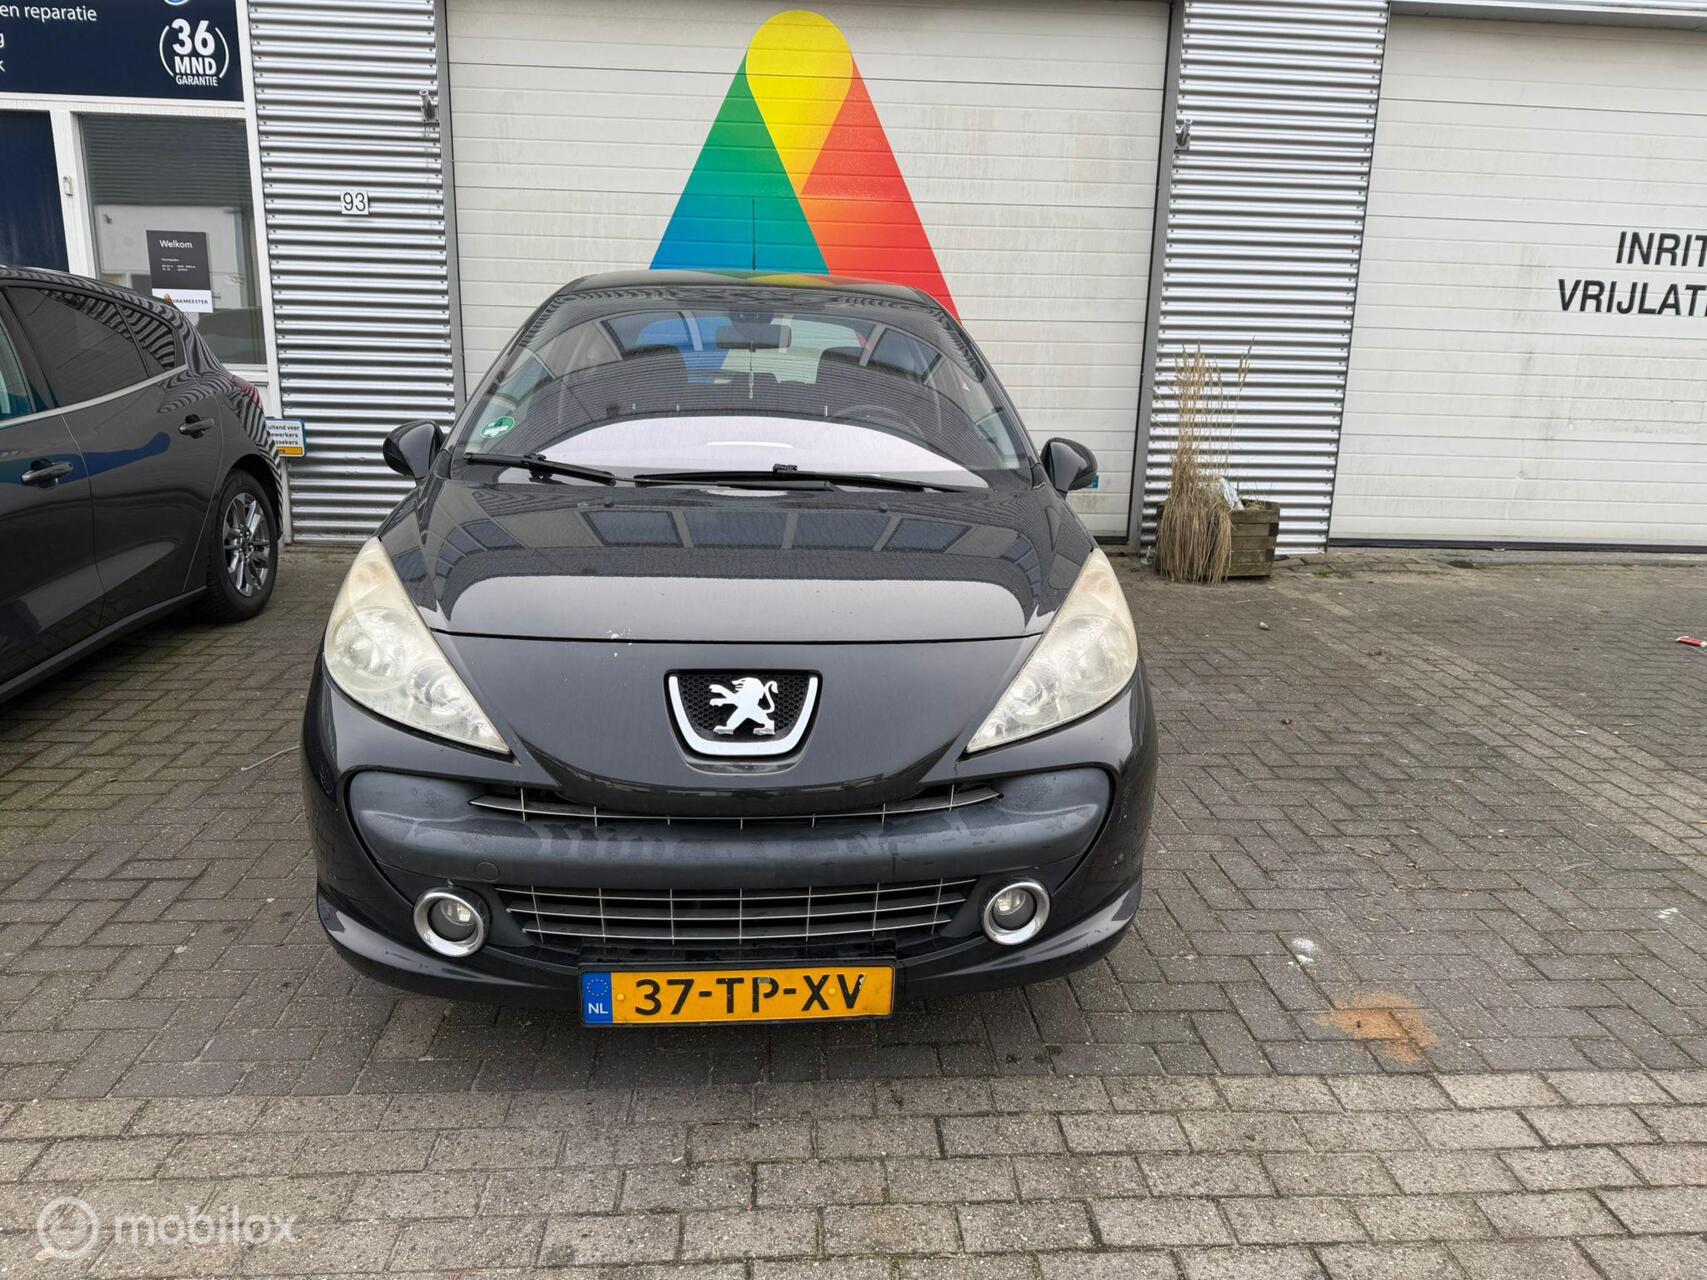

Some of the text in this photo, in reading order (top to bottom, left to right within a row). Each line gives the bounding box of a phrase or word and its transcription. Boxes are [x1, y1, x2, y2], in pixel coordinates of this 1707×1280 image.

[0, 5, 98, 23] en reparatie
[171, 18, 216, 56] 36
[174, 56, 217, 75] MND
[175, 75, 219, 87] GARANTIE
[342, 192, 367, 212] 93
[159, 239, 193, 249] Welkom
[1616, 231, 1707, 267] INRIT
[1558, 279, 1707, 317] VRIJLAT
[634, 973, 866, 1016] 37-TP-XV
[588, 1002, 609, 1015] NL
